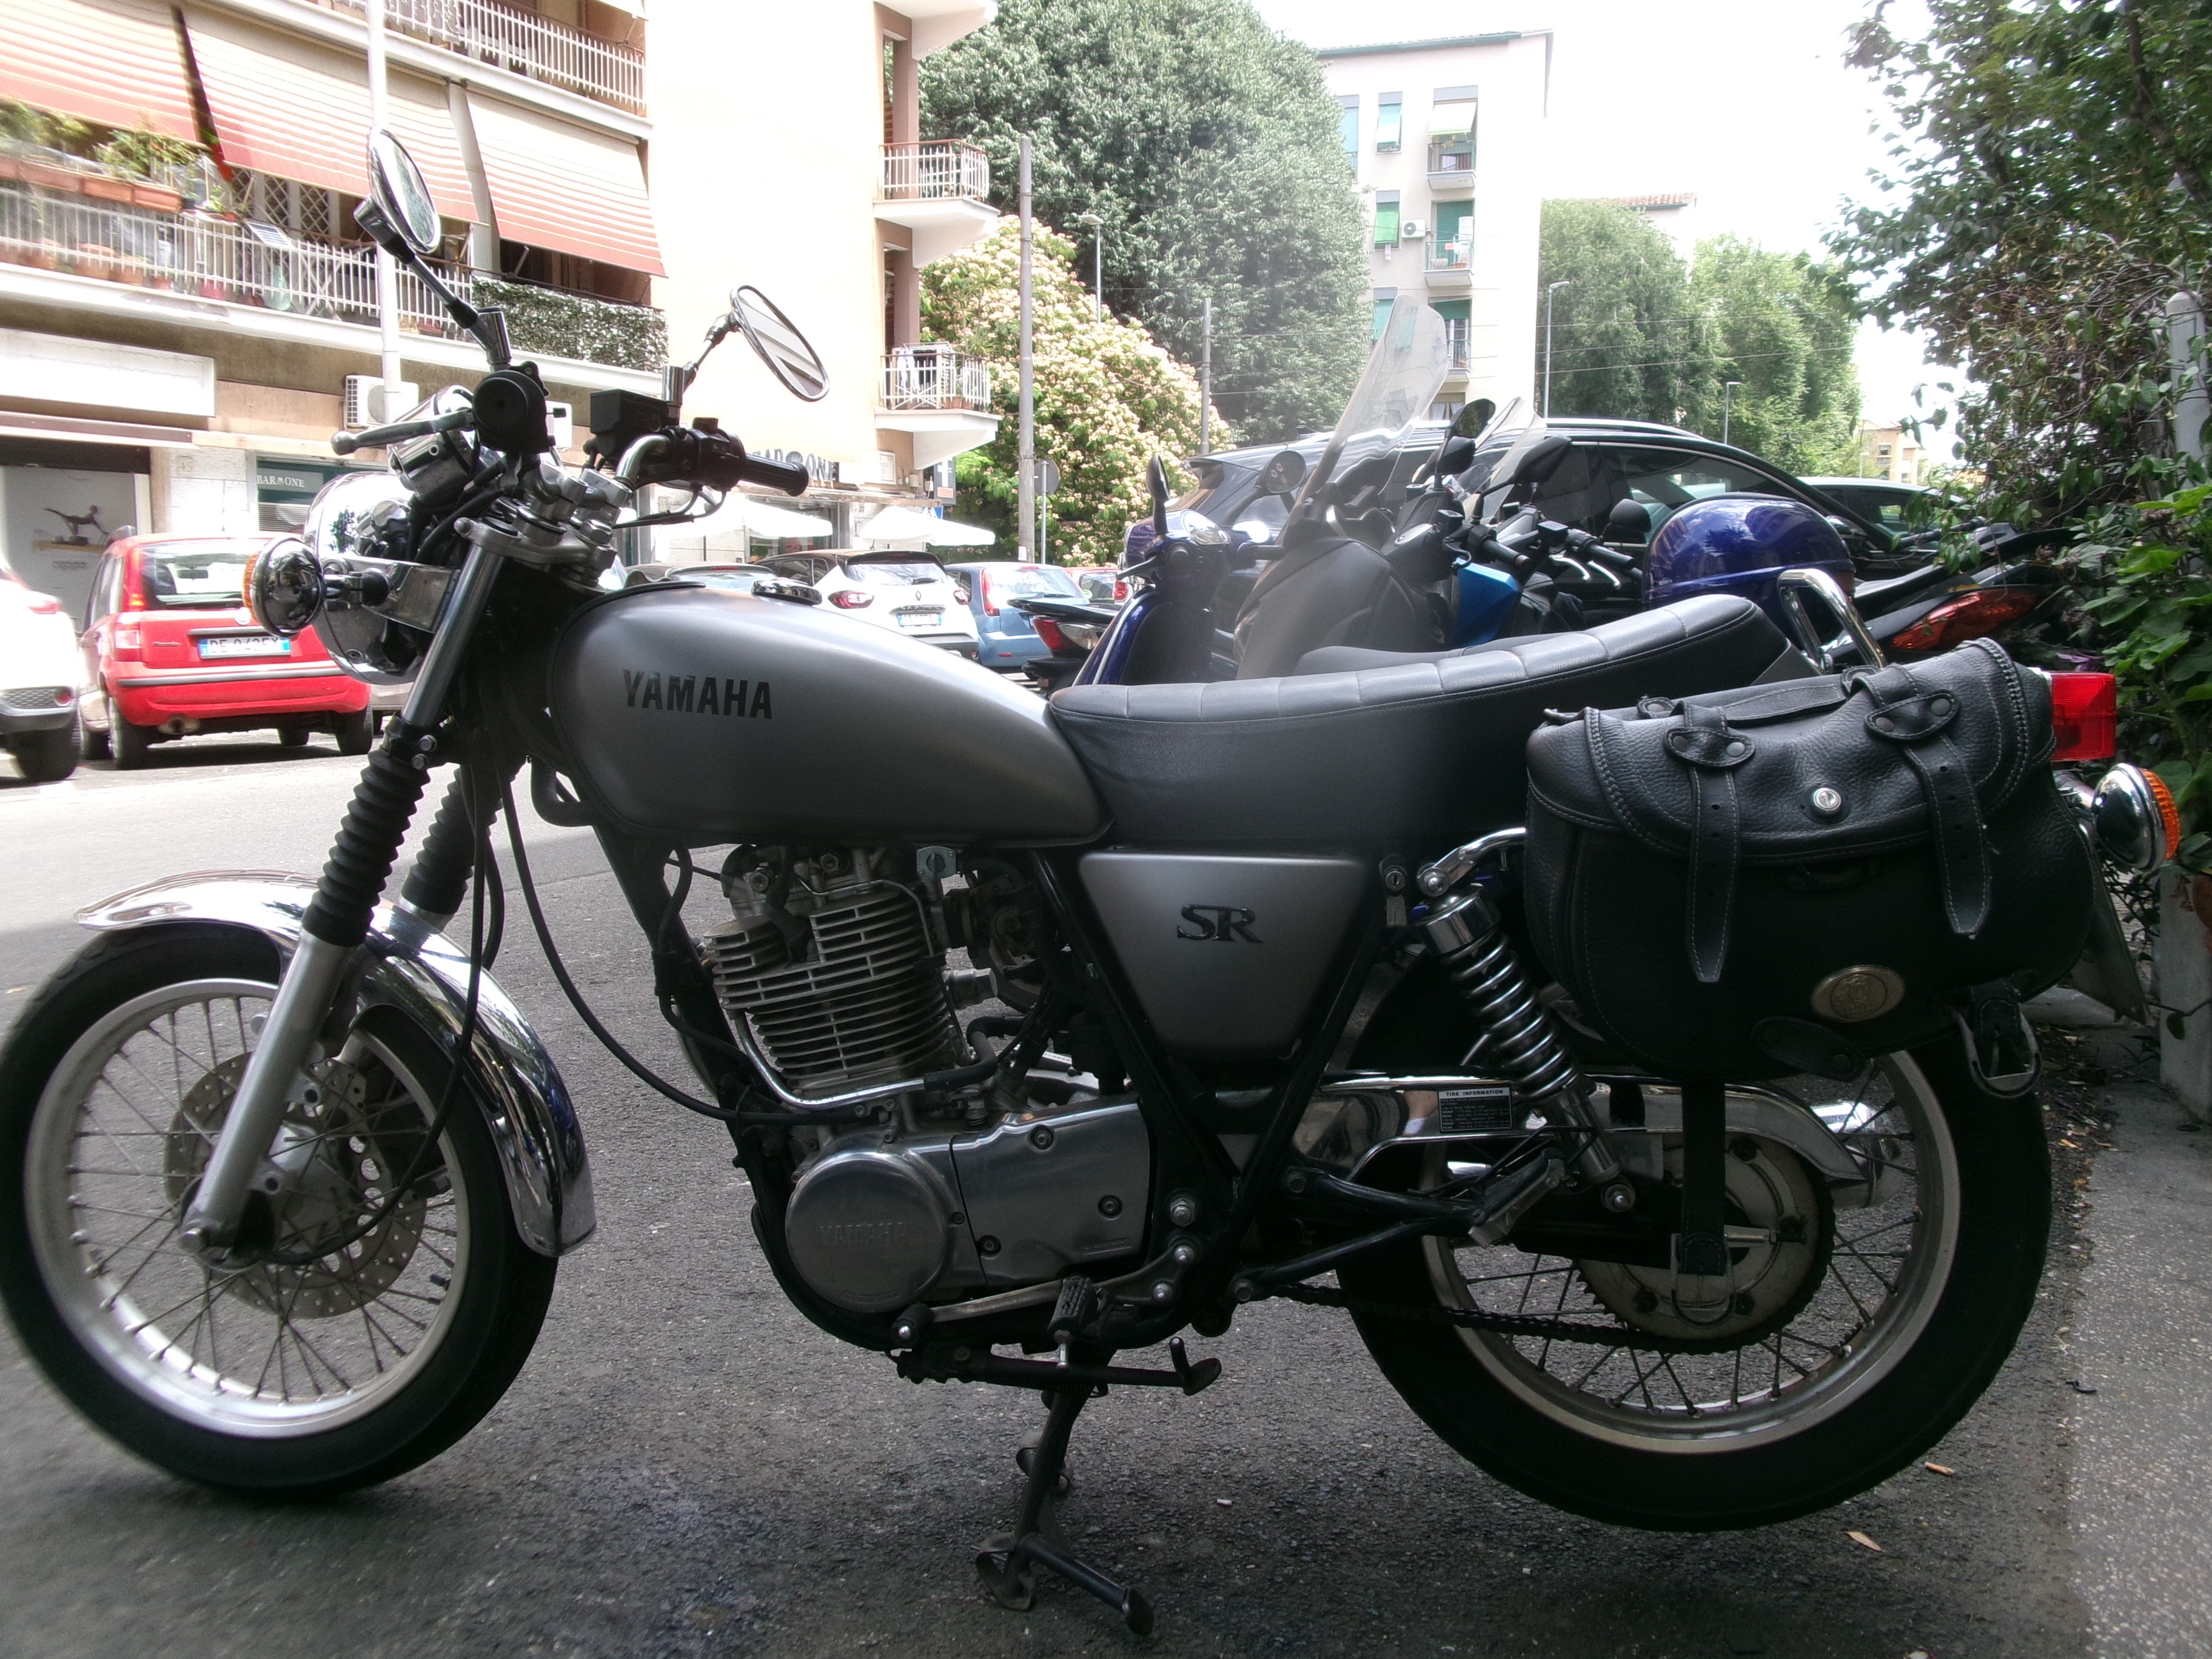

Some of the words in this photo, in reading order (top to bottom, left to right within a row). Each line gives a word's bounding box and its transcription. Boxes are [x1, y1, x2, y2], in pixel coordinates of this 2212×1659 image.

[805, 453, 836, 481] ONE
[256, 475, 276, 485] BAR
[284, 477, 305, 488] ONE
[623, 669, 773, 719] YAMAHA
[1177, 904, 1265, 943] SR
[819, 1221, 903, 1245] YAMAHA
